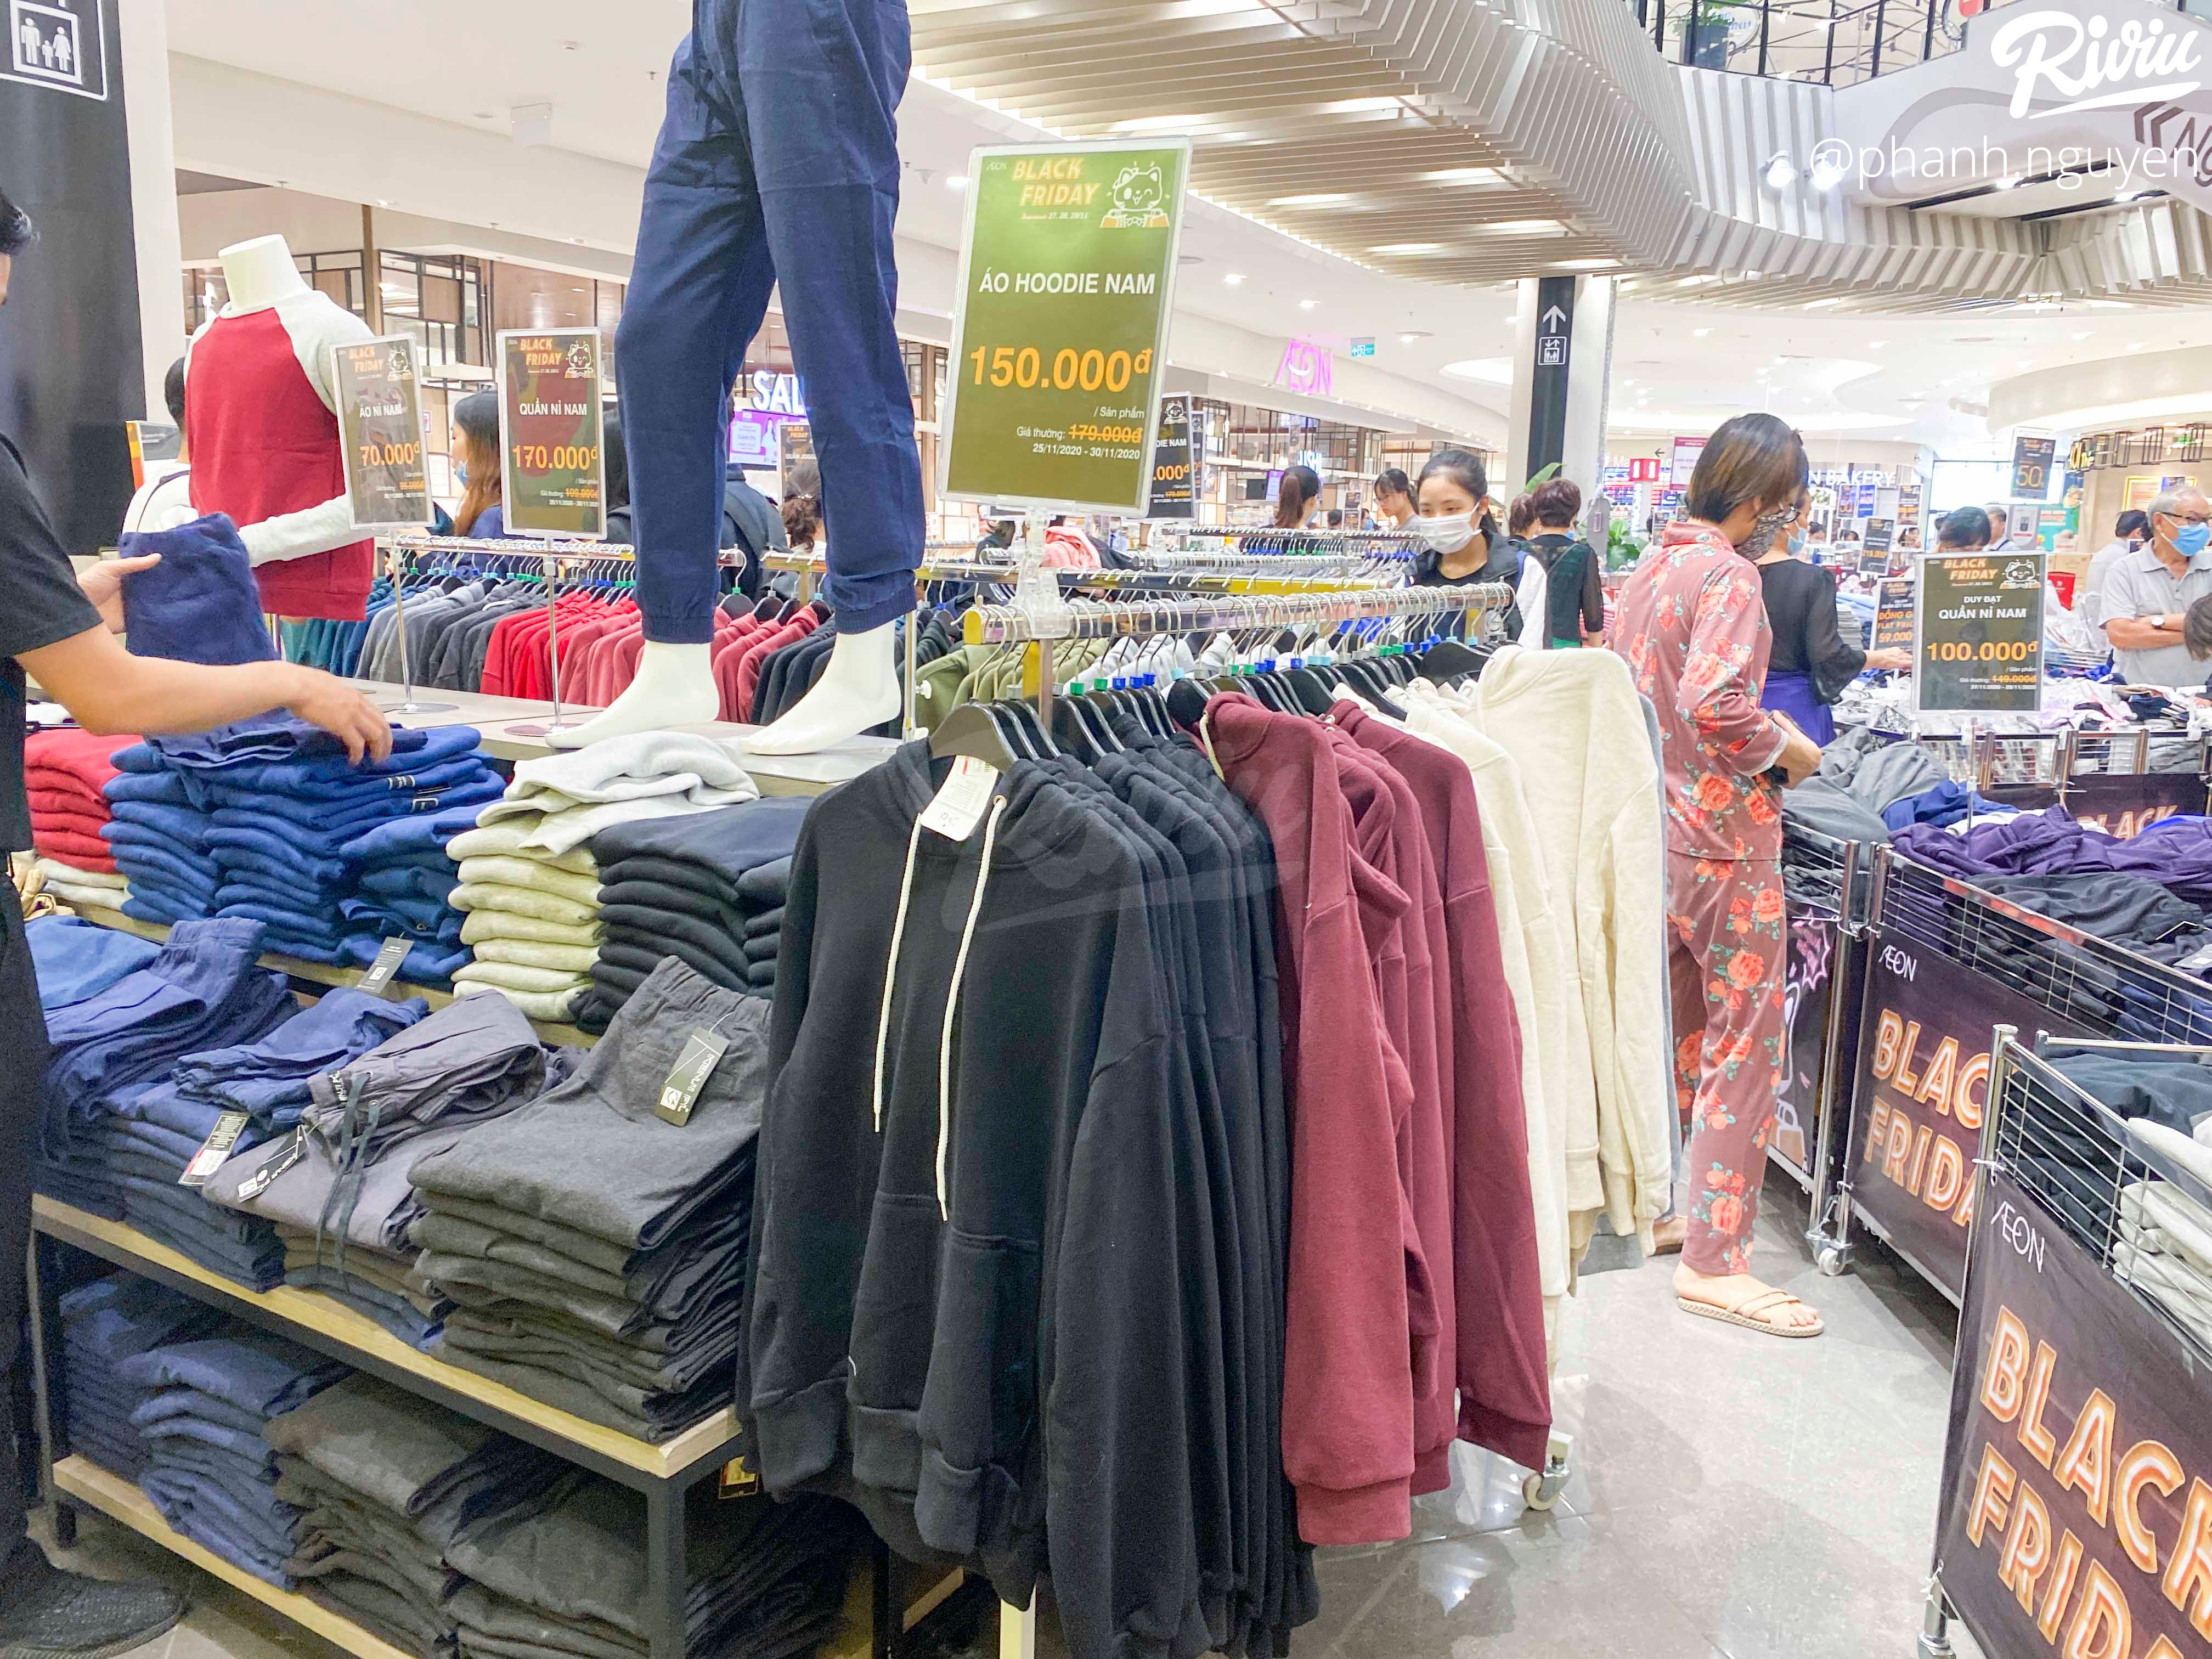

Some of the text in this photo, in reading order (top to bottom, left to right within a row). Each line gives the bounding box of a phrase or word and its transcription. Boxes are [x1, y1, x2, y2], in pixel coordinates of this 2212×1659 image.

[1012, 158, 1084, 181] BLACK
[1019, 183, 1101, 206] FRIDAY
[979, 267, 1155, 295] ÁO HOODIE NAM
[520, 338, 553, 351] BLACK
[526, 353, 562, 365] FRIDAY
[970, 346, 1153, 392] 150.000đ
[753, 371, 806, 417] SAL
[565, 403, 587, 416] NAM
[1033, 443, 1081, 456] 25/11/2020
[1090, 447, 1140, 459] 30/11/2020
[1169, 439, 1187, 447] NAM
[1944, 558, 1988, 569] BLACK
[1950, 569, 1999, 580] FRIDAY
[1996, 608, 2027, 618] NAM
[1927, 641, 2039, 662] 100.000đ
[1872, 1008, 1990, 1129] BLAC
[1967, 1442, 2185, 1659] FRID
